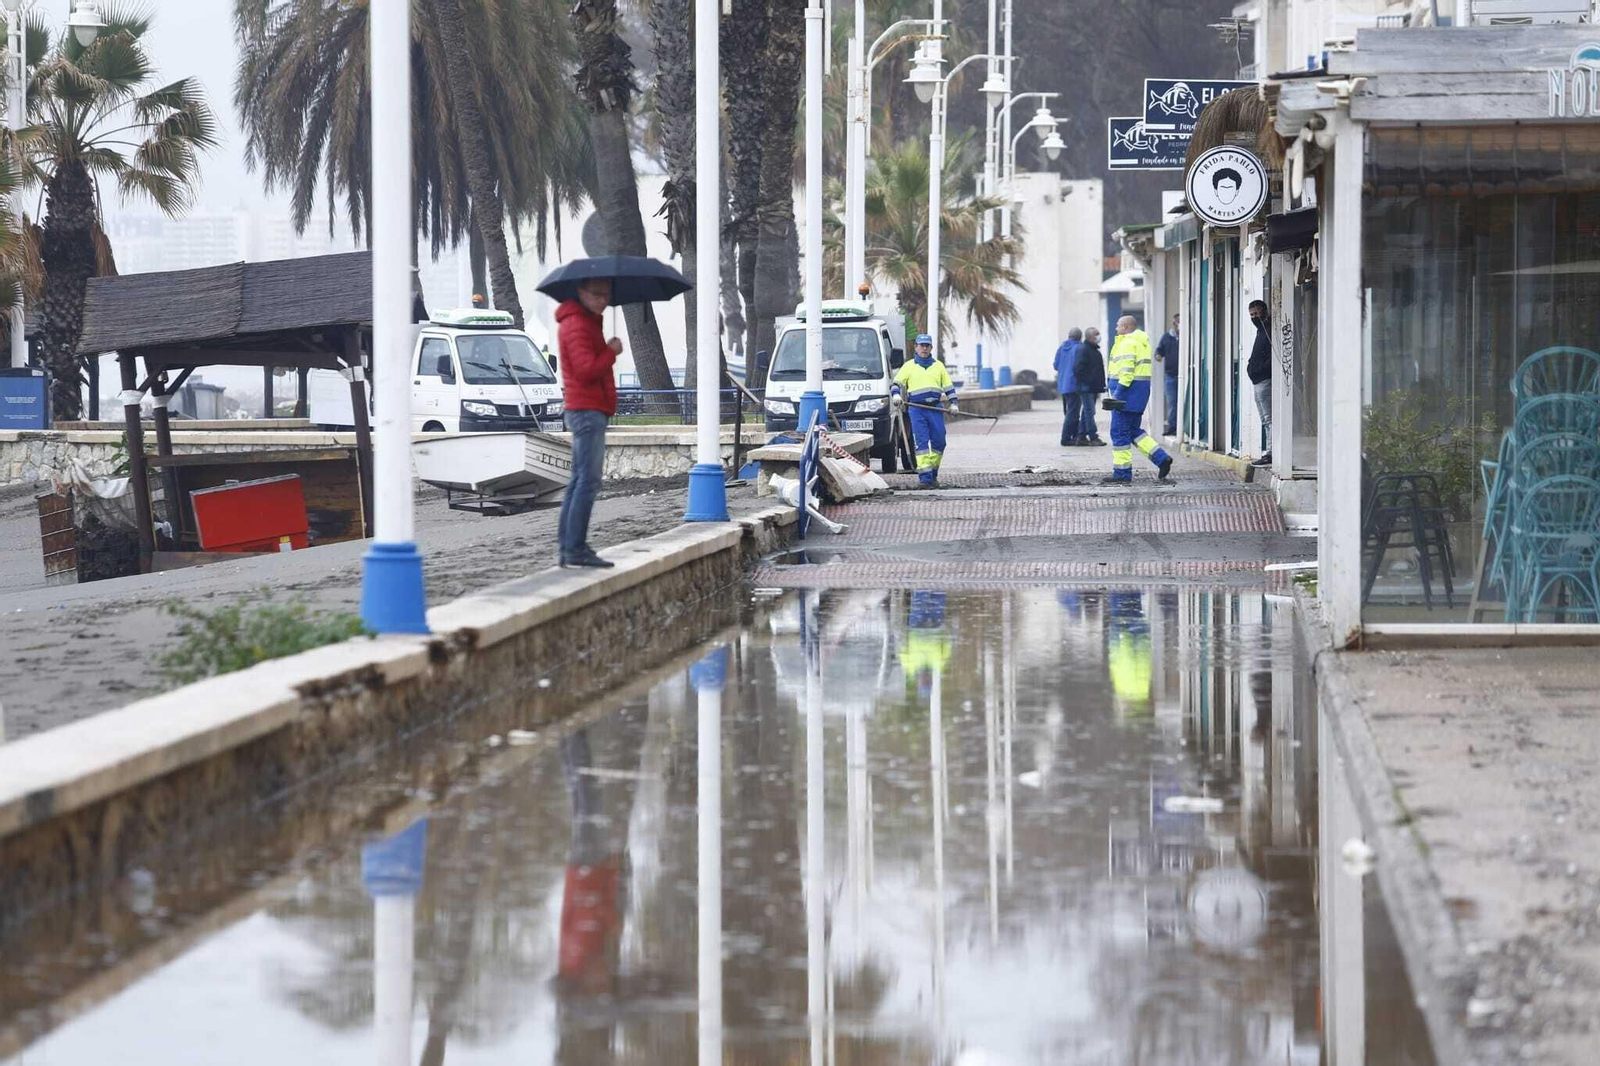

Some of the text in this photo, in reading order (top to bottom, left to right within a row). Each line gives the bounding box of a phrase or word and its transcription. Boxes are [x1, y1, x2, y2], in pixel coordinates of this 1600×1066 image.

[1199, 156, 1225, 175] FRIDA
[1228, 155, 1256, 175] PAHLO
[532, 387, 554, 396] 9705
[844, 383, 872, 392] 9708
